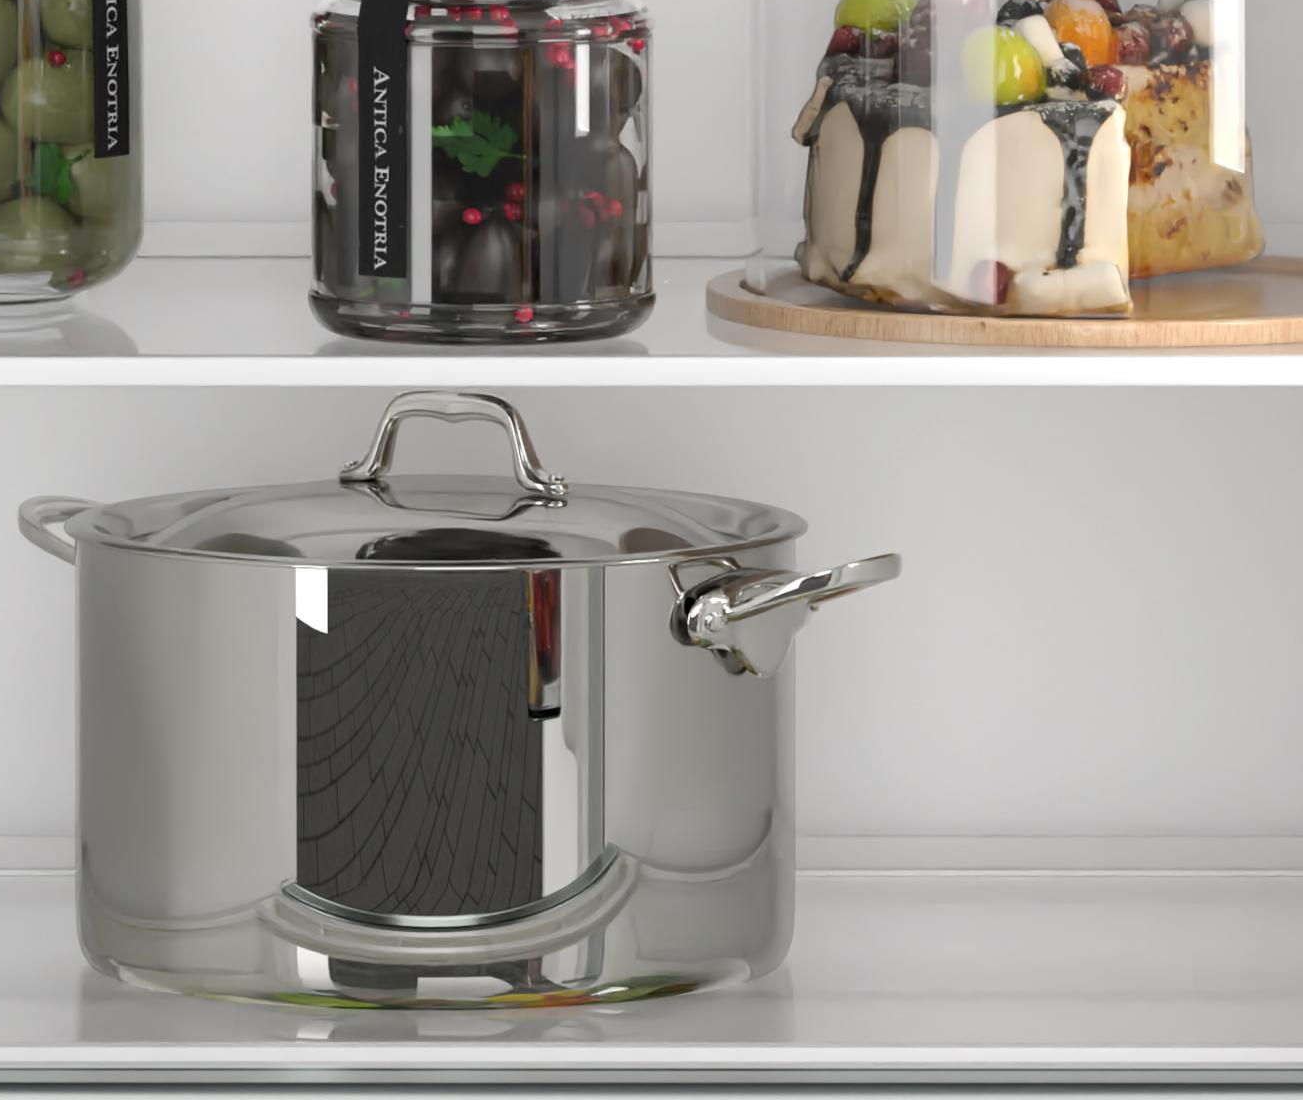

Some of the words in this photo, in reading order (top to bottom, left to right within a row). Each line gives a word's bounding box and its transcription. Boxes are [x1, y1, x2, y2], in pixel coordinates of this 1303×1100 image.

[105, 44, 120, 151] ENOTRIA
[373, 66, 390, 160] ANTICA
[373, 165, 390, 270] ENOTRIA
